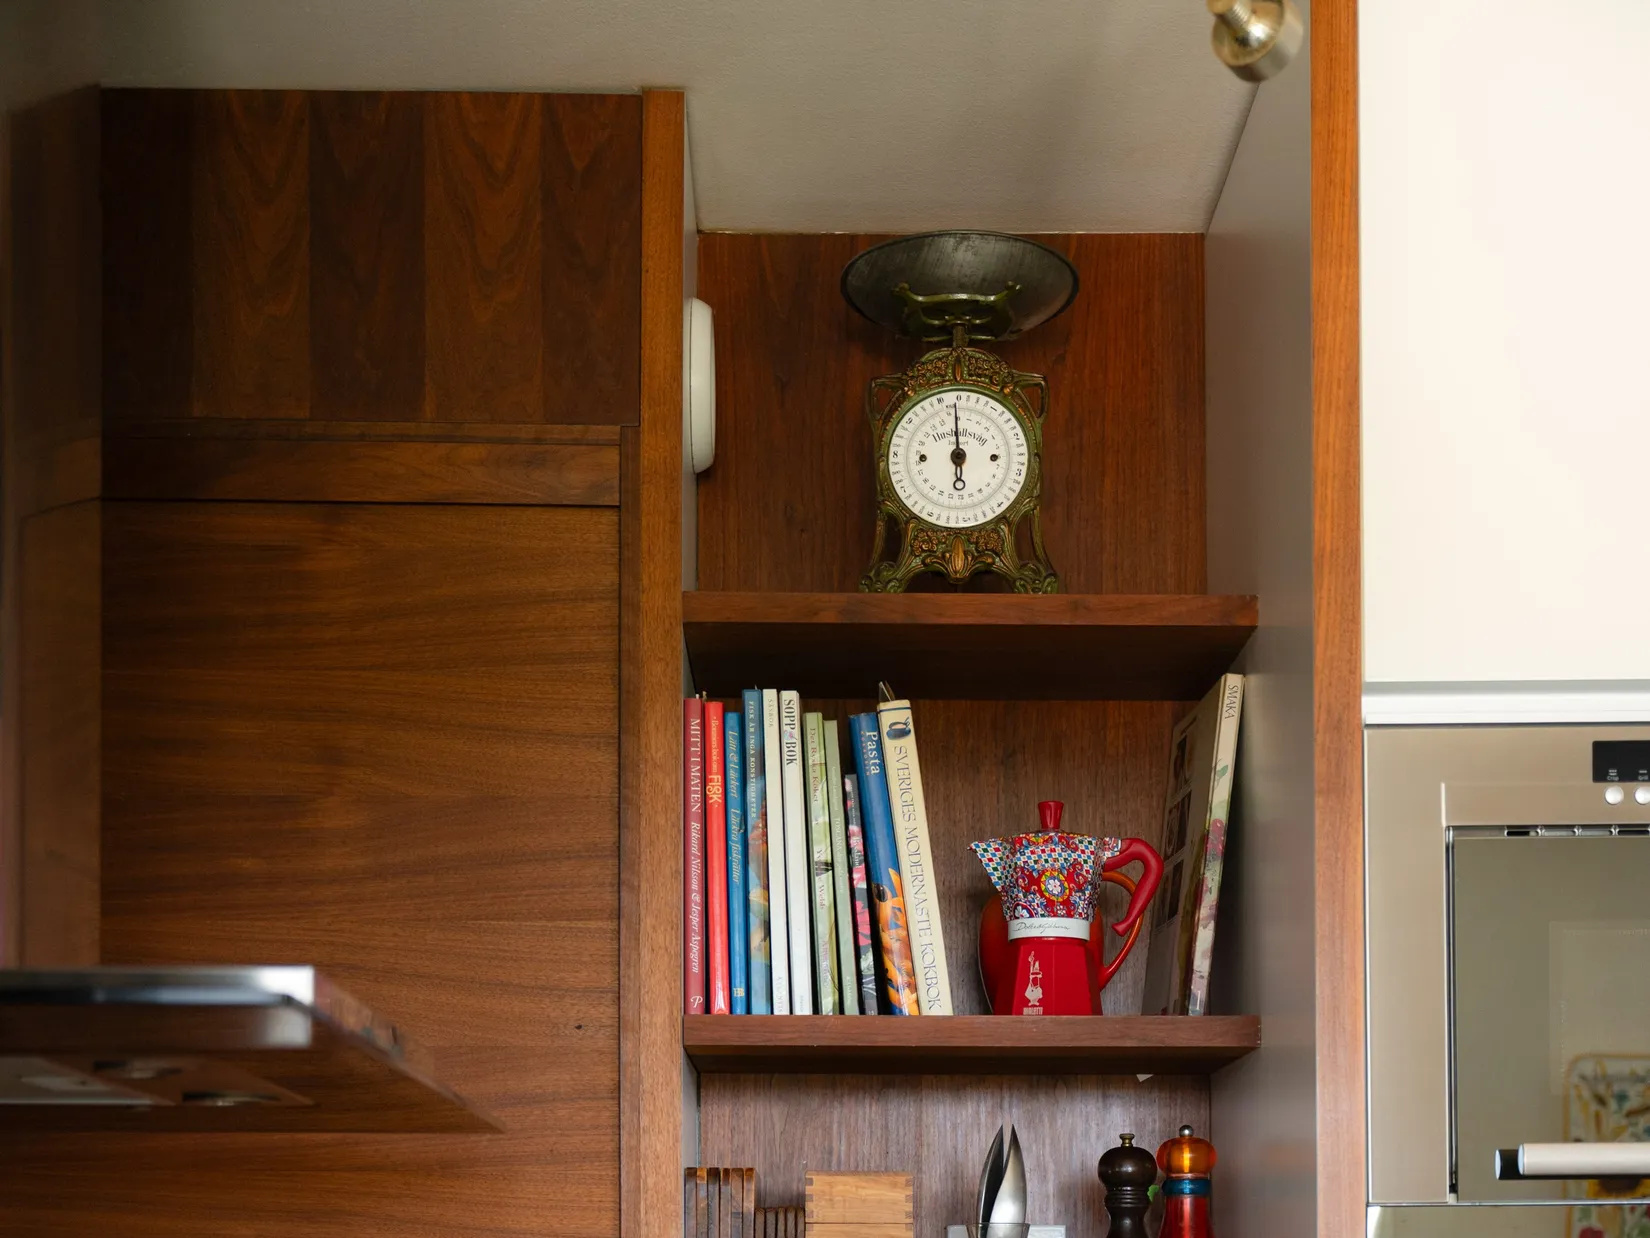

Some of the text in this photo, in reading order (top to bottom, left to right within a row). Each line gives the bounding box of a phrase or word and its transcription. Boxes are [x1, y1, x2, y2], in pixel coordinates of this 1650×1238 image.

[893, 450, 898, 458] 8
[1016, 468, 1022, 477] 3
[1225, 685, 1239, 719] SMAKA
[690, 719, 700, 754] MITT
[784, 699, 797, 766] SOPP BOK
[712, 762, 718, 772] om
[866, 731, 881, 774] Pasta
[690, 765, 701, 812] MATEN
[706, 775, 721, 803] FISK
[728, 731, 741, 884] Lätt & Läckert Läckra fiskrätter
[691, 822, 702, 854] Rikard
[834, 817, 843, 851] TOSCANA
[691, 857, 700, 891] Nilsson
[894, 746, 941, 1010] SVERIGES MODERNASTE KOKBOK
[691, 893, 699, 902] &
[688, 903, 699, 930] Jesper
[690, 931, 700, 973] Aspegren
